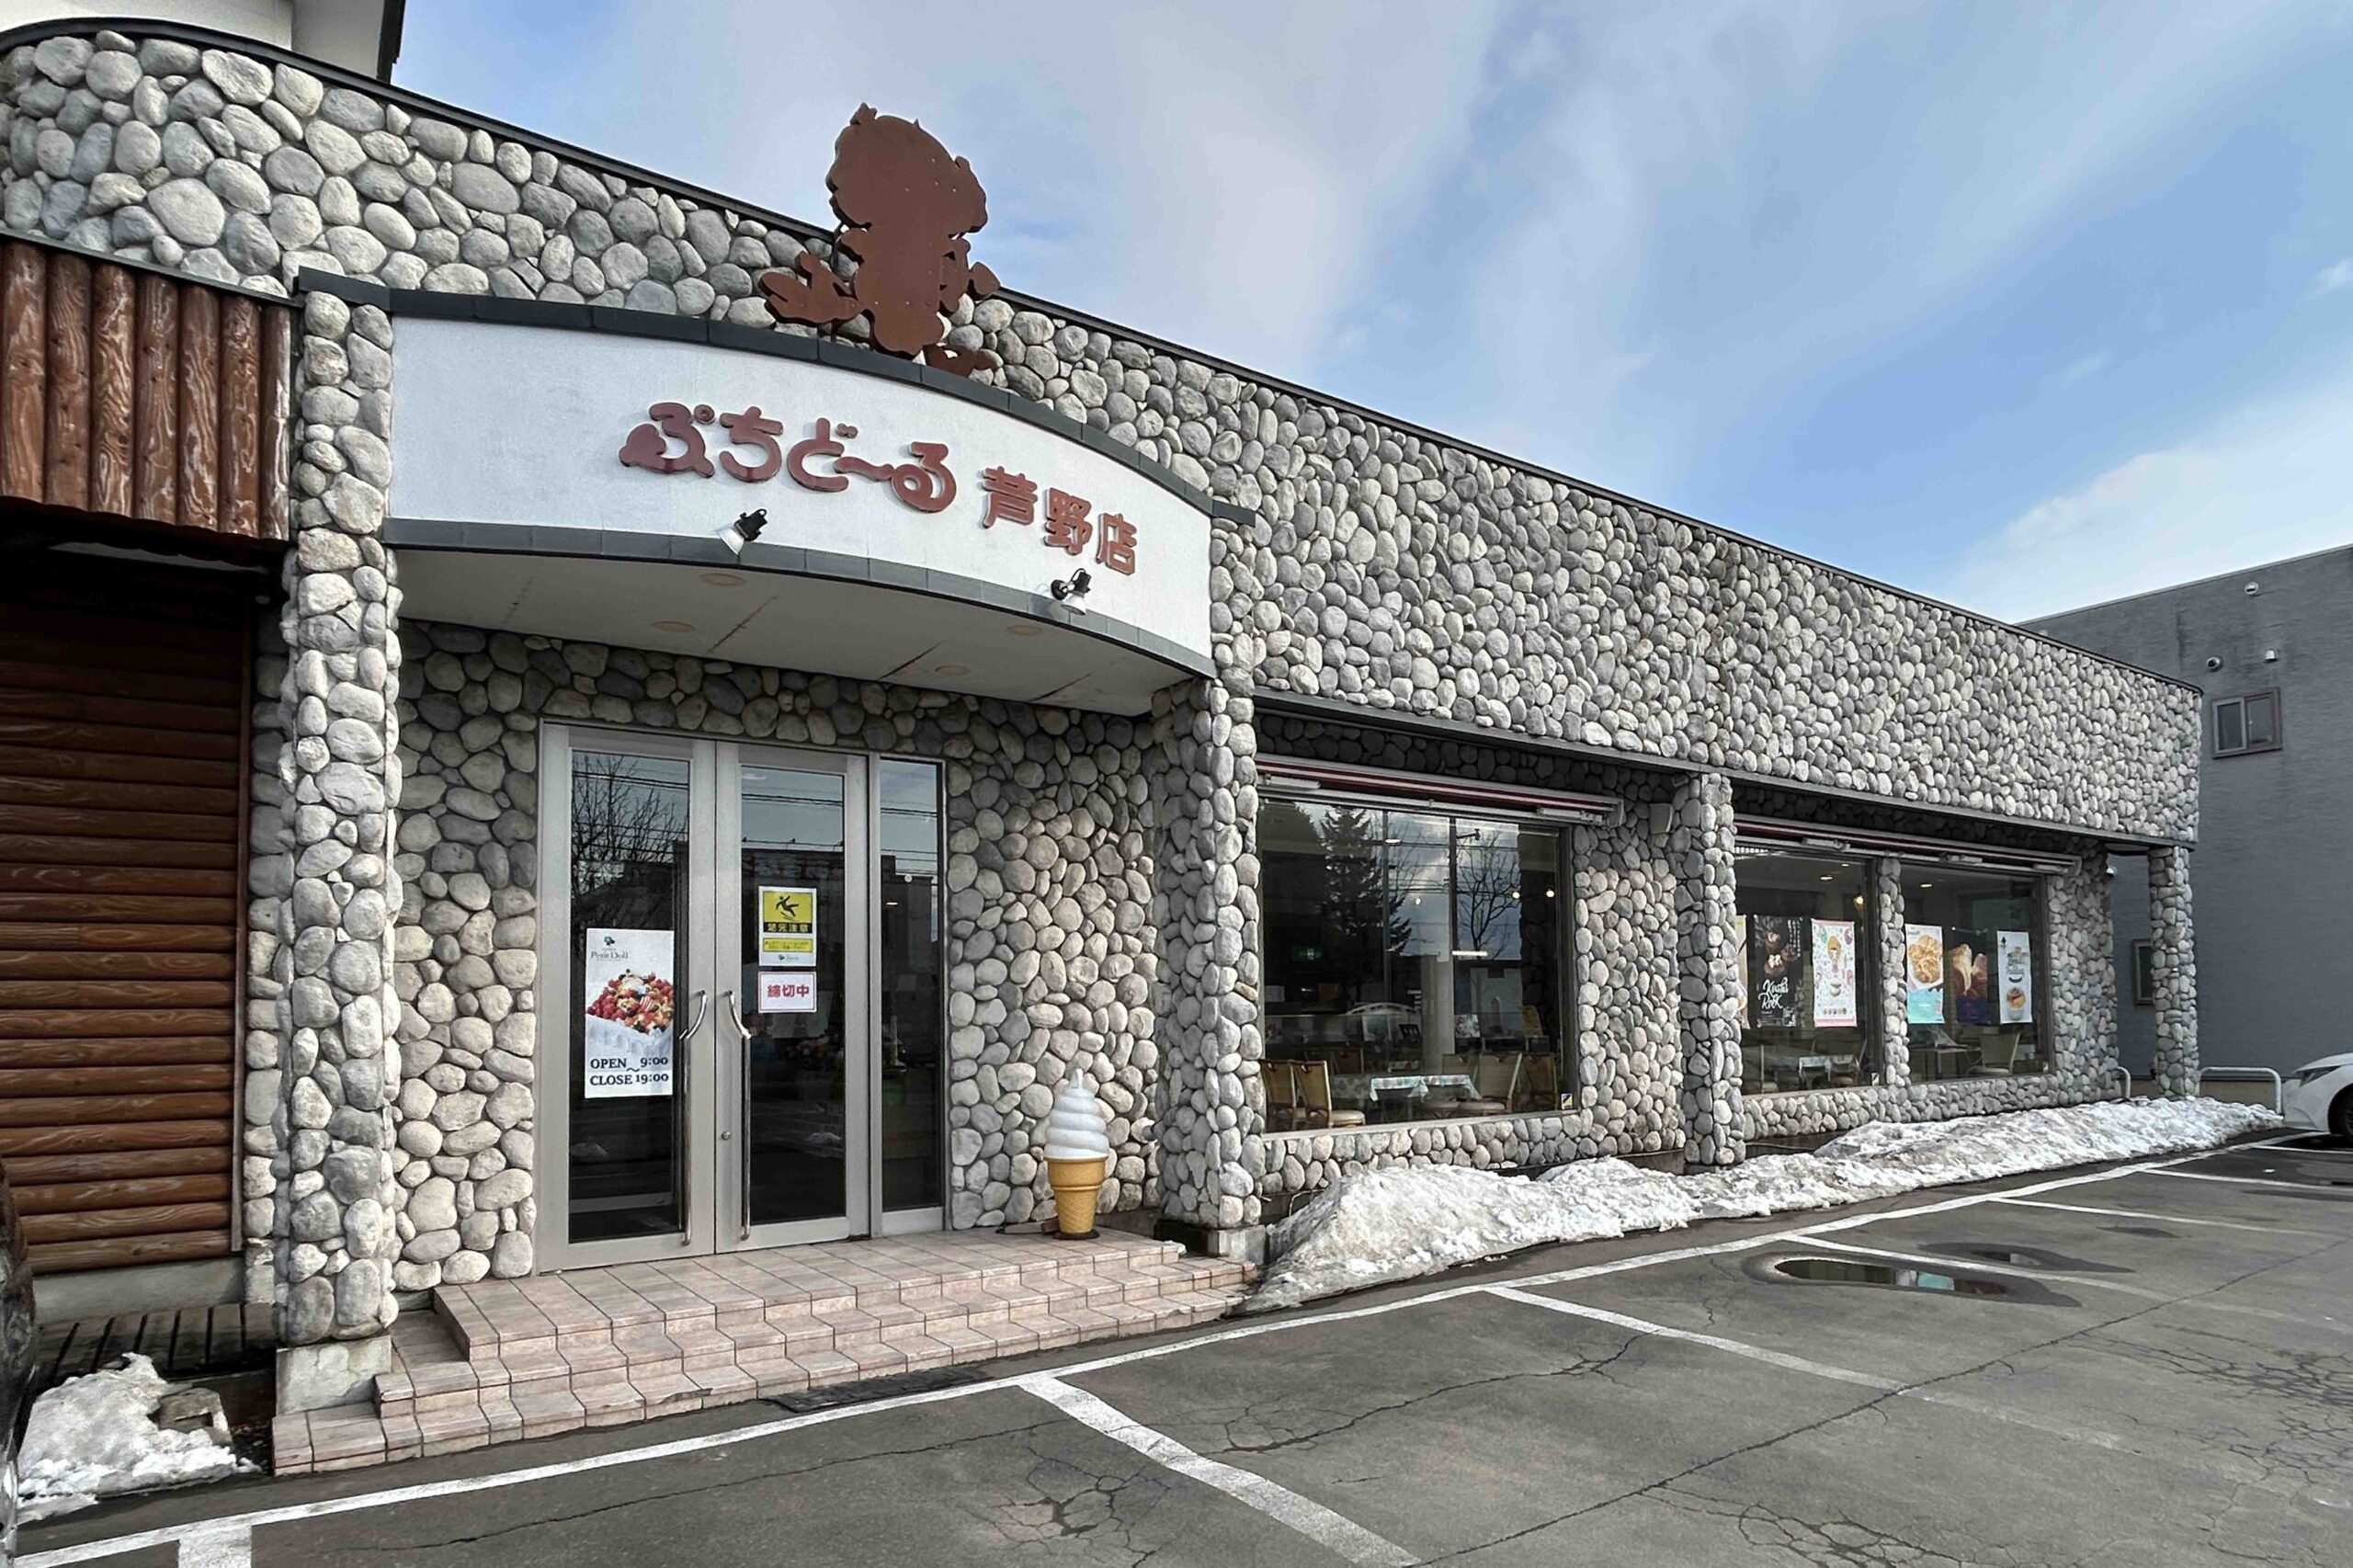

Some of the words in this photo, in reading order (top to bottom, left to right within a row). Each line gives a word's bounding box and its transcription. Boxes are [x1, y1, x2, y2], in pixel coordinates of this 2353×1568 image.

[982, 465, 1138, 575] 芦野店
[590, 1058, 627, 1069] OPEN
[640, 1056, 668, 1067] 9:00
[590, 1075, 632, 1085] CLOSE
[635, 1073, 669, 1083] 19:00
